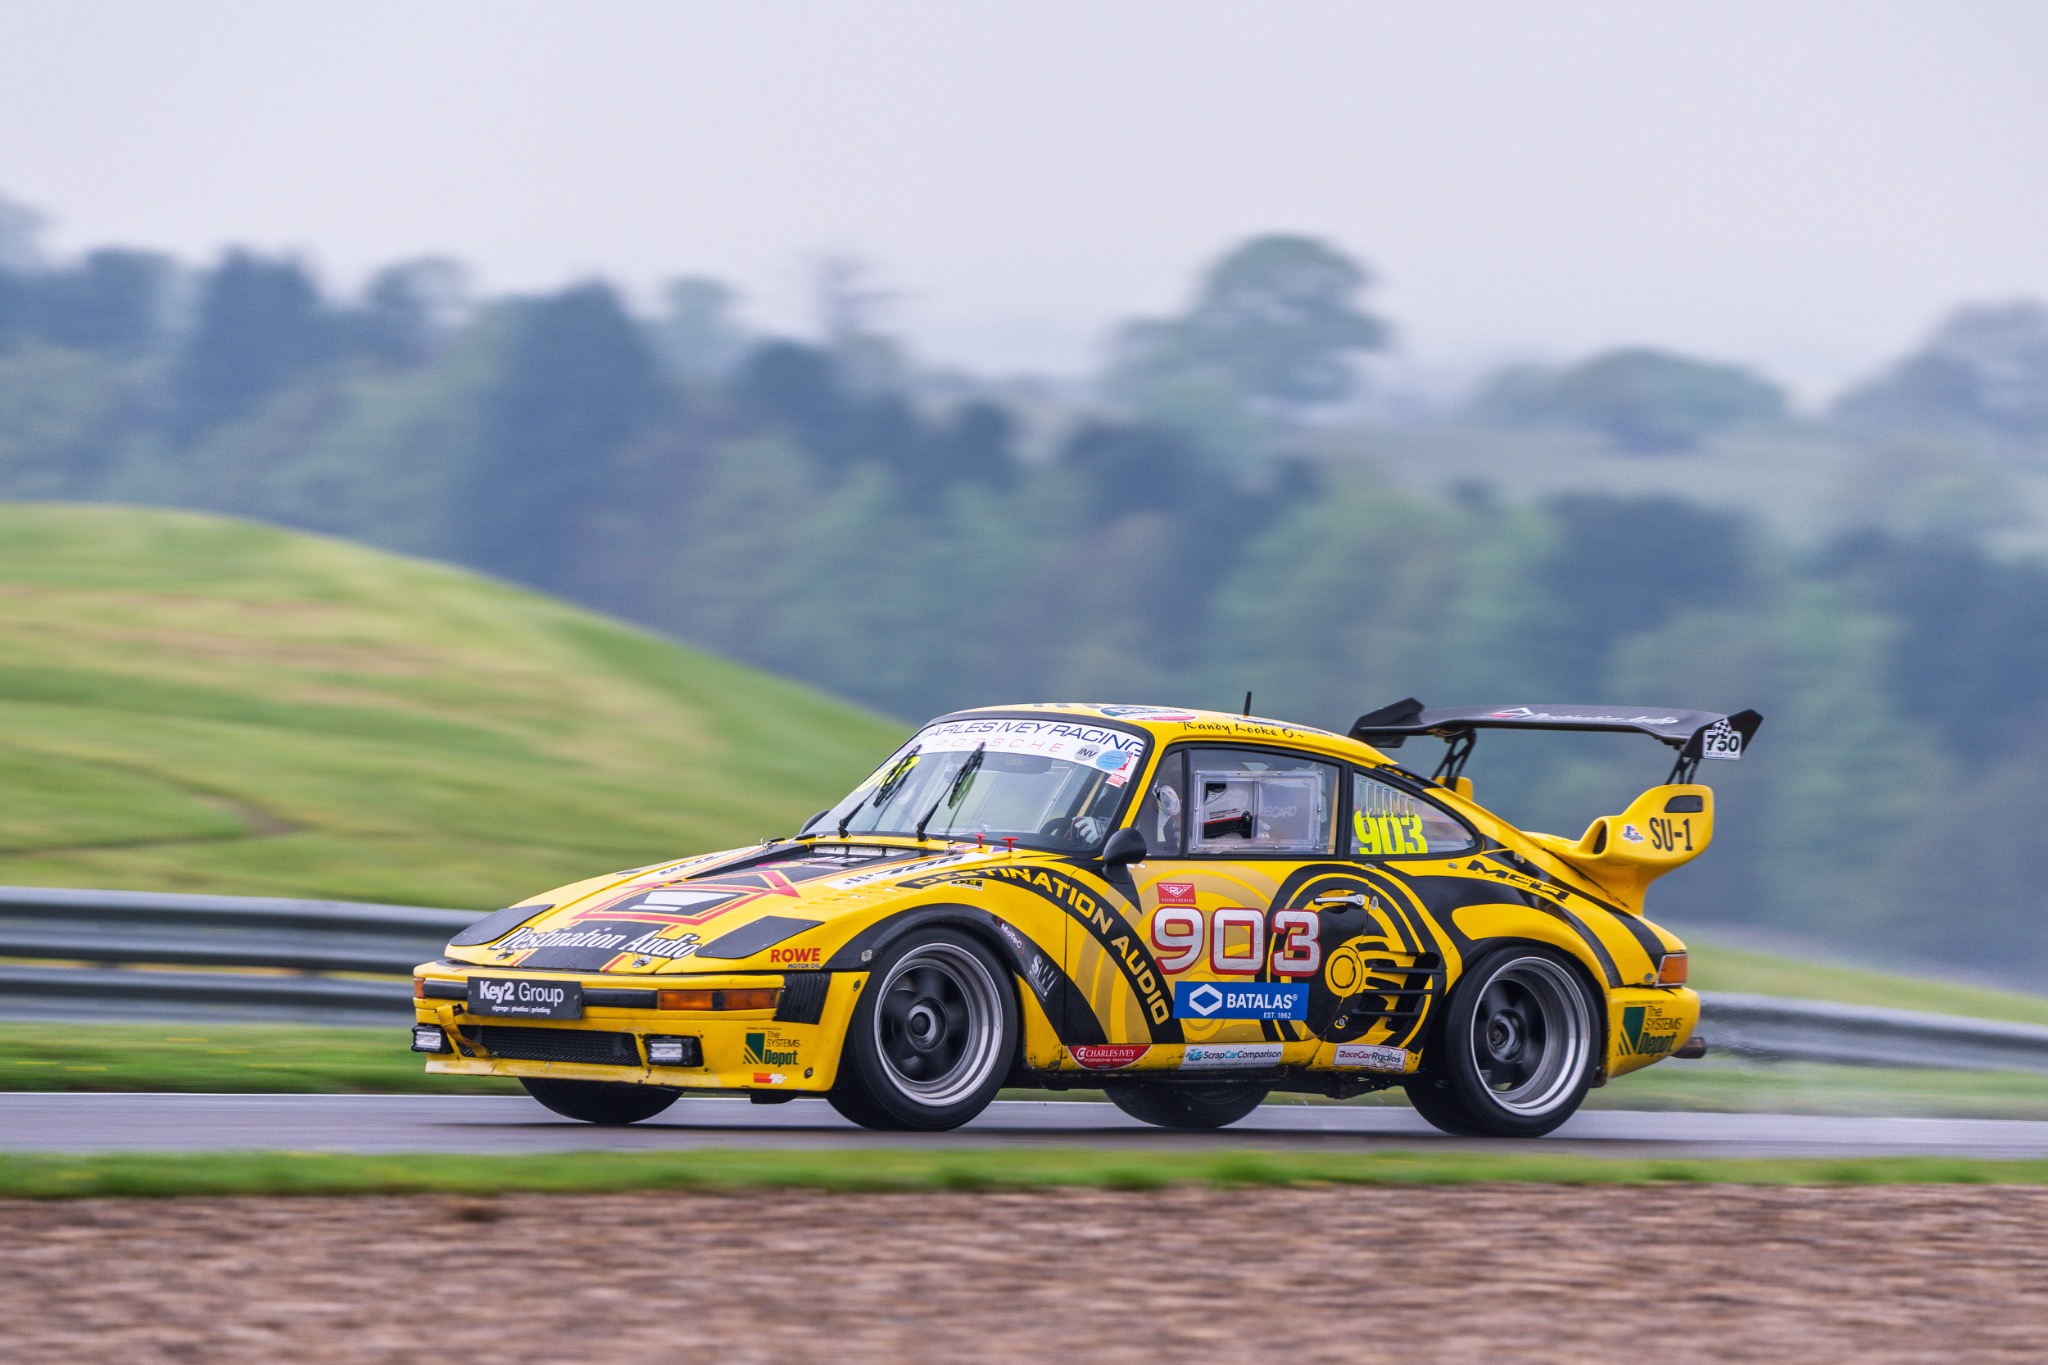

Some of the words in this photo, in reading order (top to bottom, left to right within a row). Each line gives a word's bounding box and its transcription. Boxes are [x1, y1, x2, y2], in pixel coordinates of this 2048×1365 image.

[935, 737, 1065, 753] PORSCHE
[996, 721, 1046, 734] IVEY
[1048, 724, 1144, 757] RACING
[1706, 734, 1740, 752] 750
[1077, 747, 1098, 758] INV
[1353, 809, 1428, 855] 903
[1649, 817, 1694, 852] SU-1
[492, 927, 627, 951] Destination
[617, 929, 701, 960] Audio
[911, 866, 1113, 935] DESTINATION
[1111, 935, 1170, 1026] AUDIO
[1151, 906, 1322, 977] 903
[770, 947, 821, 963] ROWE
[480, 980, 515, 1004] Key2
[518, 982, 564, 1007] Group
[1263, 1011, 1275, 1019] EST.
[1643, 1017, 1683, 1031] SYSTEMS
[767, 1030, 781, 1039] The
[766, 1038, 801, 1048] SYSTEMS
[763, 1048, 799, 1067] Depot
[1085, 1049, 1118, 1058] CHARLES
[1118, 1049, 1136, 1058] IVEY
[1203, 1049, 1282, 1061] ScrapCarComparison
[1338, 1050, 1402, 1064] RaceCarRadios
